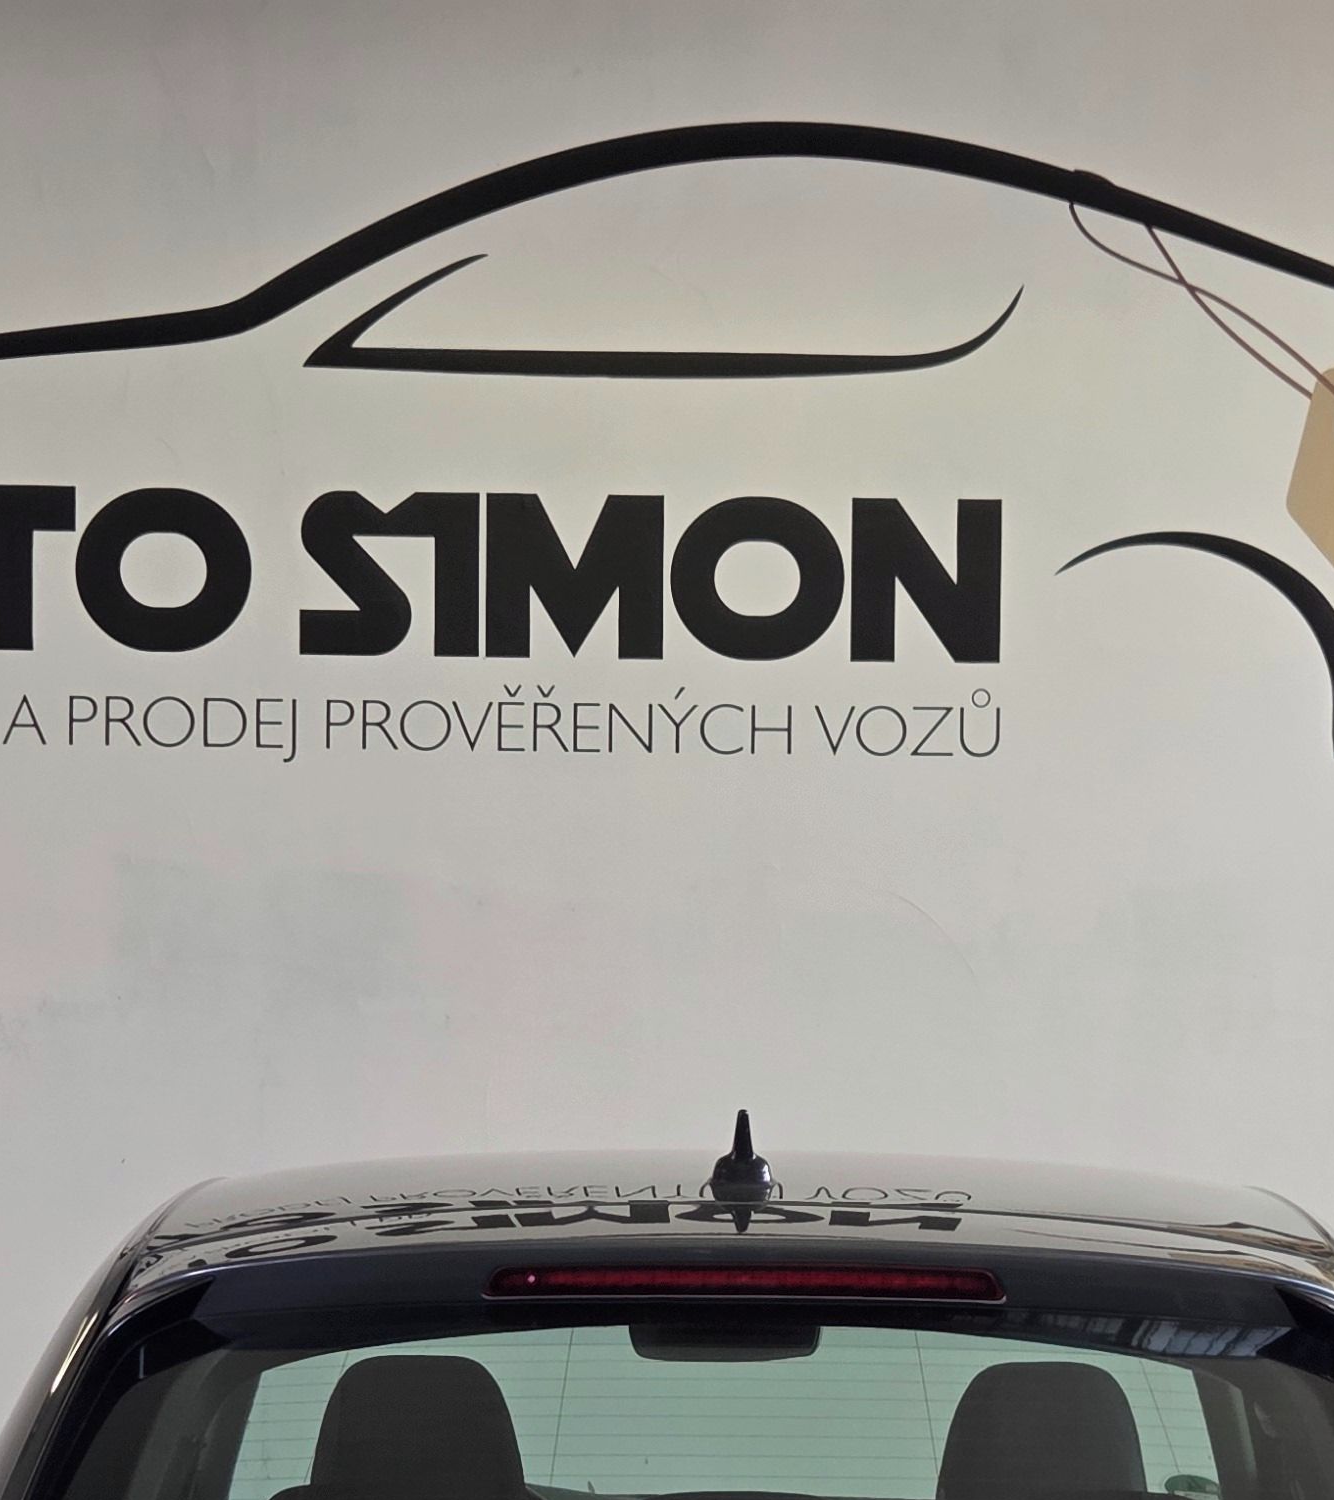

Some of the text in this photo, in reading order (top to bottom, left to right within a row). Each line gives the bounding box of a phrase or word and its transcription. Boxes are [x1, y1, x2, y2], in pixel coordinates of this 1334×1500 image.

[299, 489, 1003, 664] SIMON
[2, 694, 47, 745] A
[68, 695, 298, 763] PRODEJ
[326, 684, 793, 756] PROVĚŘENÝCH
[814, 688, 1001, 758] VOZŮ
